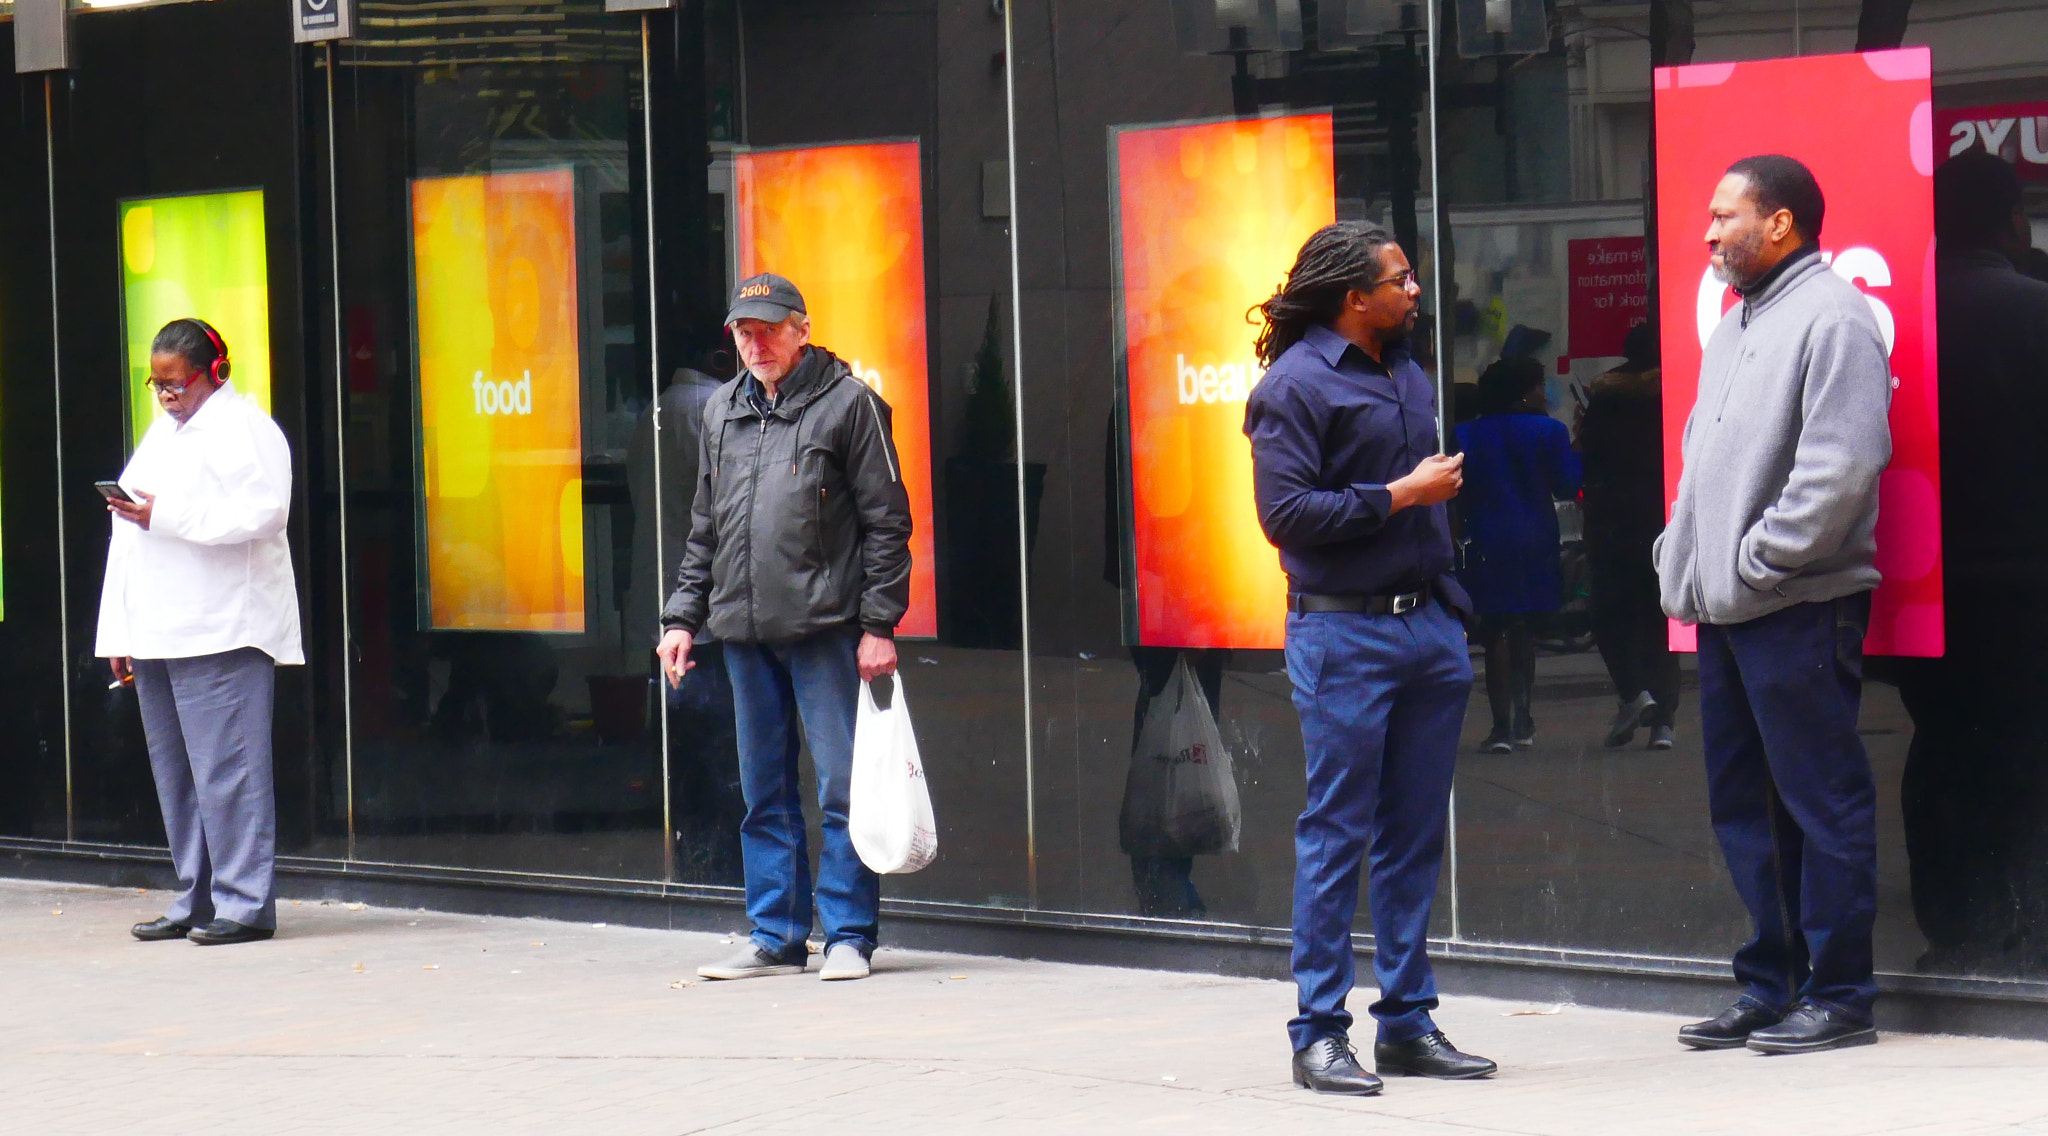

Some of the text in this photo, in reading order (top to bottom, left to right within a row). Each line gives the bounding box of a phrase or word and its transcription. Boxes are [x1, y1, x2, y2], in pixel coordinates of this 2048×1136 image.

[740, 284, 770, 299] 2600
[472, 370, 532, 415] food
[1177, 353, 1266, 405] beau
